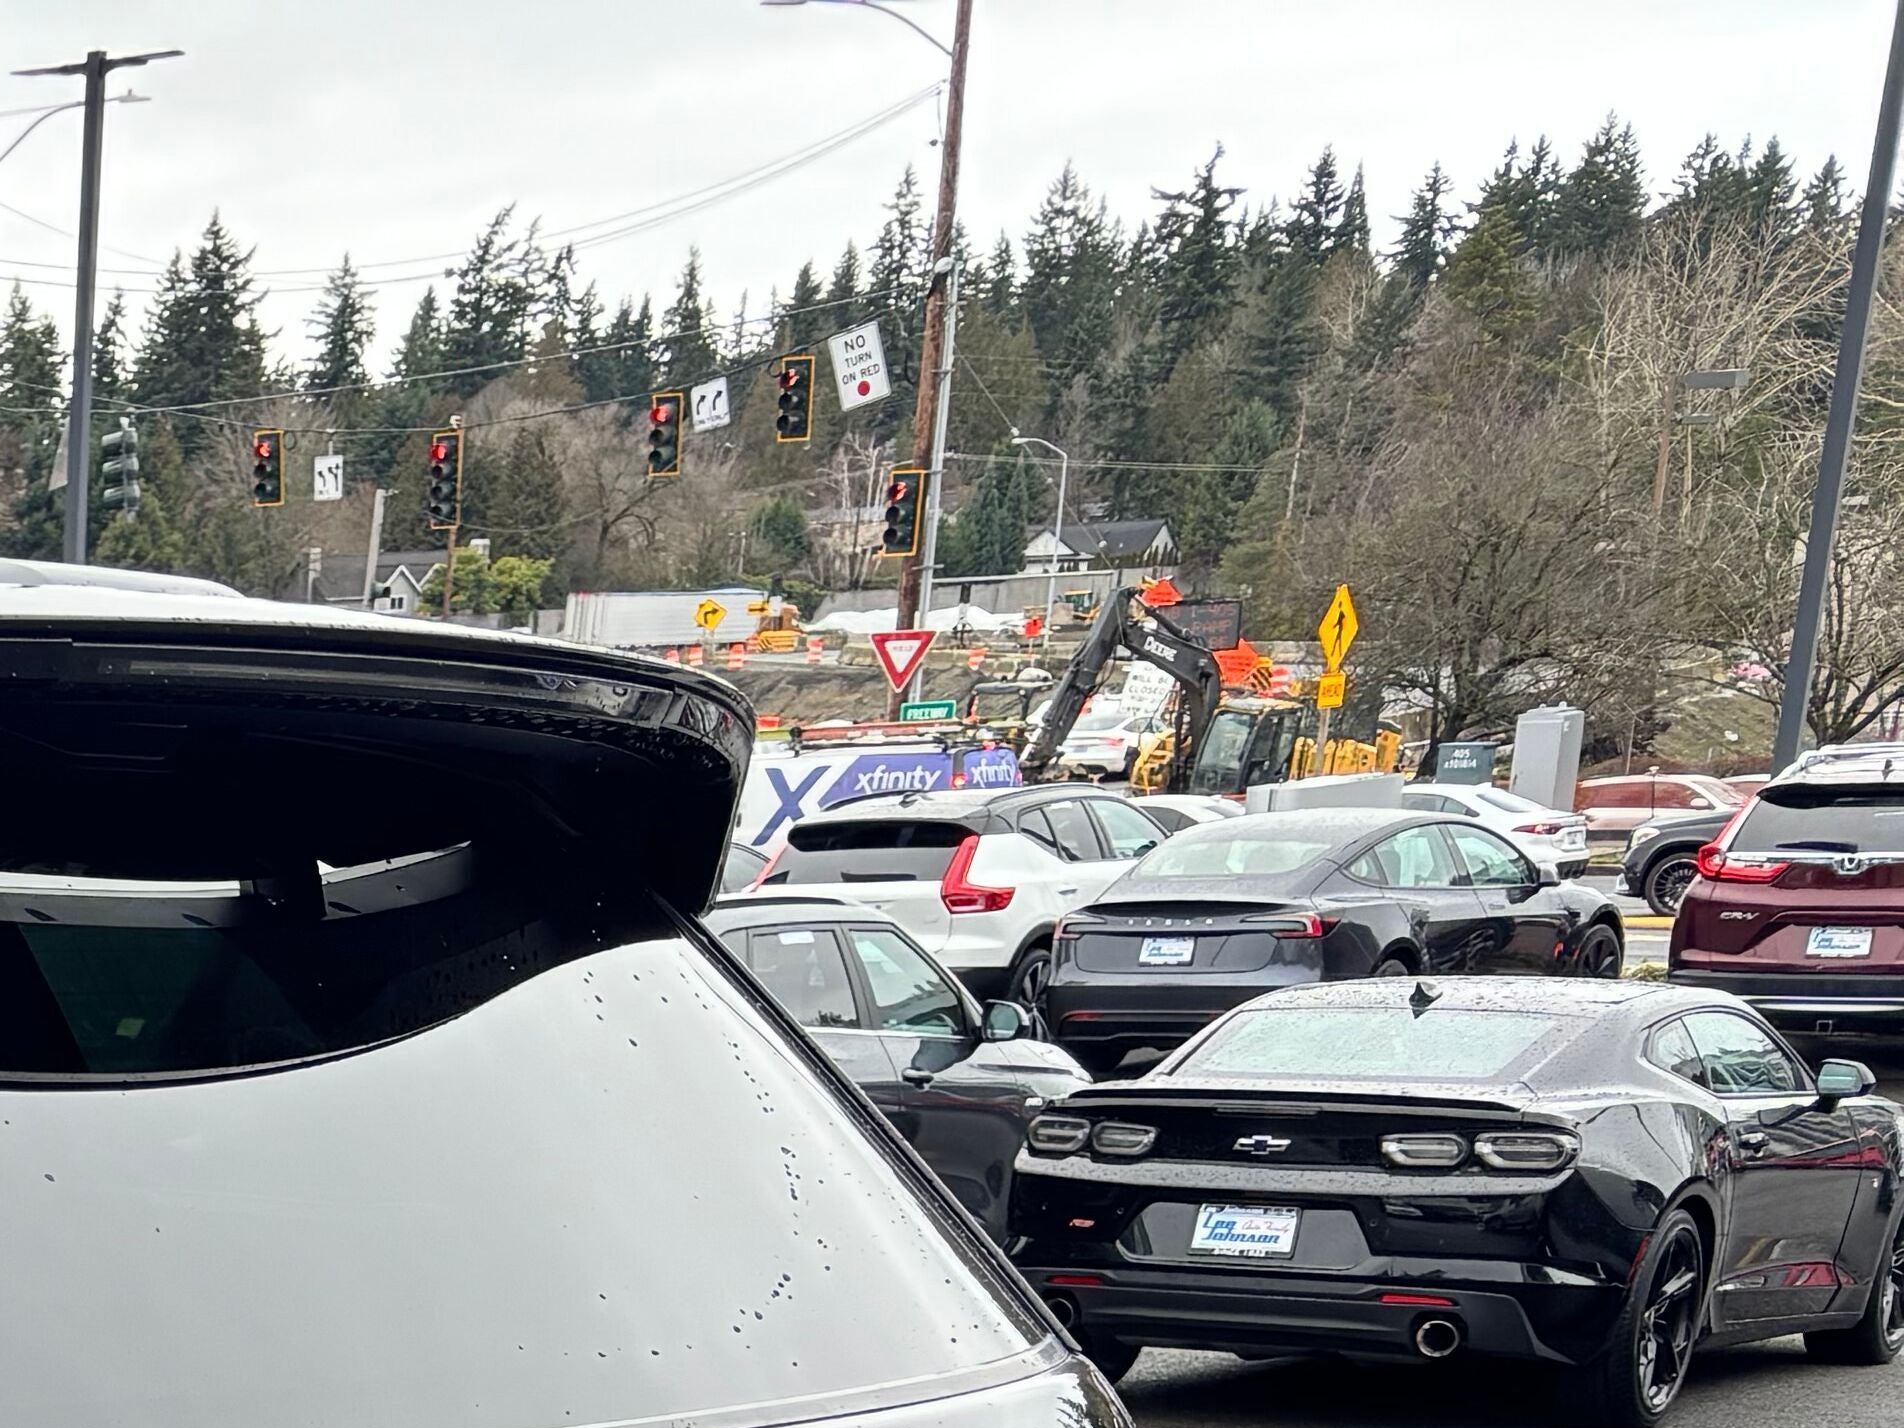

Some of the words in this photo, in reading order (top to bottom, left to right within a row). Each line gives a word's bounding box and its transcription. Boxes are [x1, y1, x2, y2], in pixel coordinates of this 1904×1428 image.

[844, 334, 865, 353] NO
[844, 351, 873, 368] TURN
[842, 371, 857, 385] ON
[859, 363, 881, 378] RED
[1144, 636, 1177, 662] DEERE
[854, 764, 942, 794] xfinity
[971, 758, 1016, 788] xfinity
[1203, 1211, 1237, 1230] Lee
[1201, 1227, 1281, 1244] Johnson
